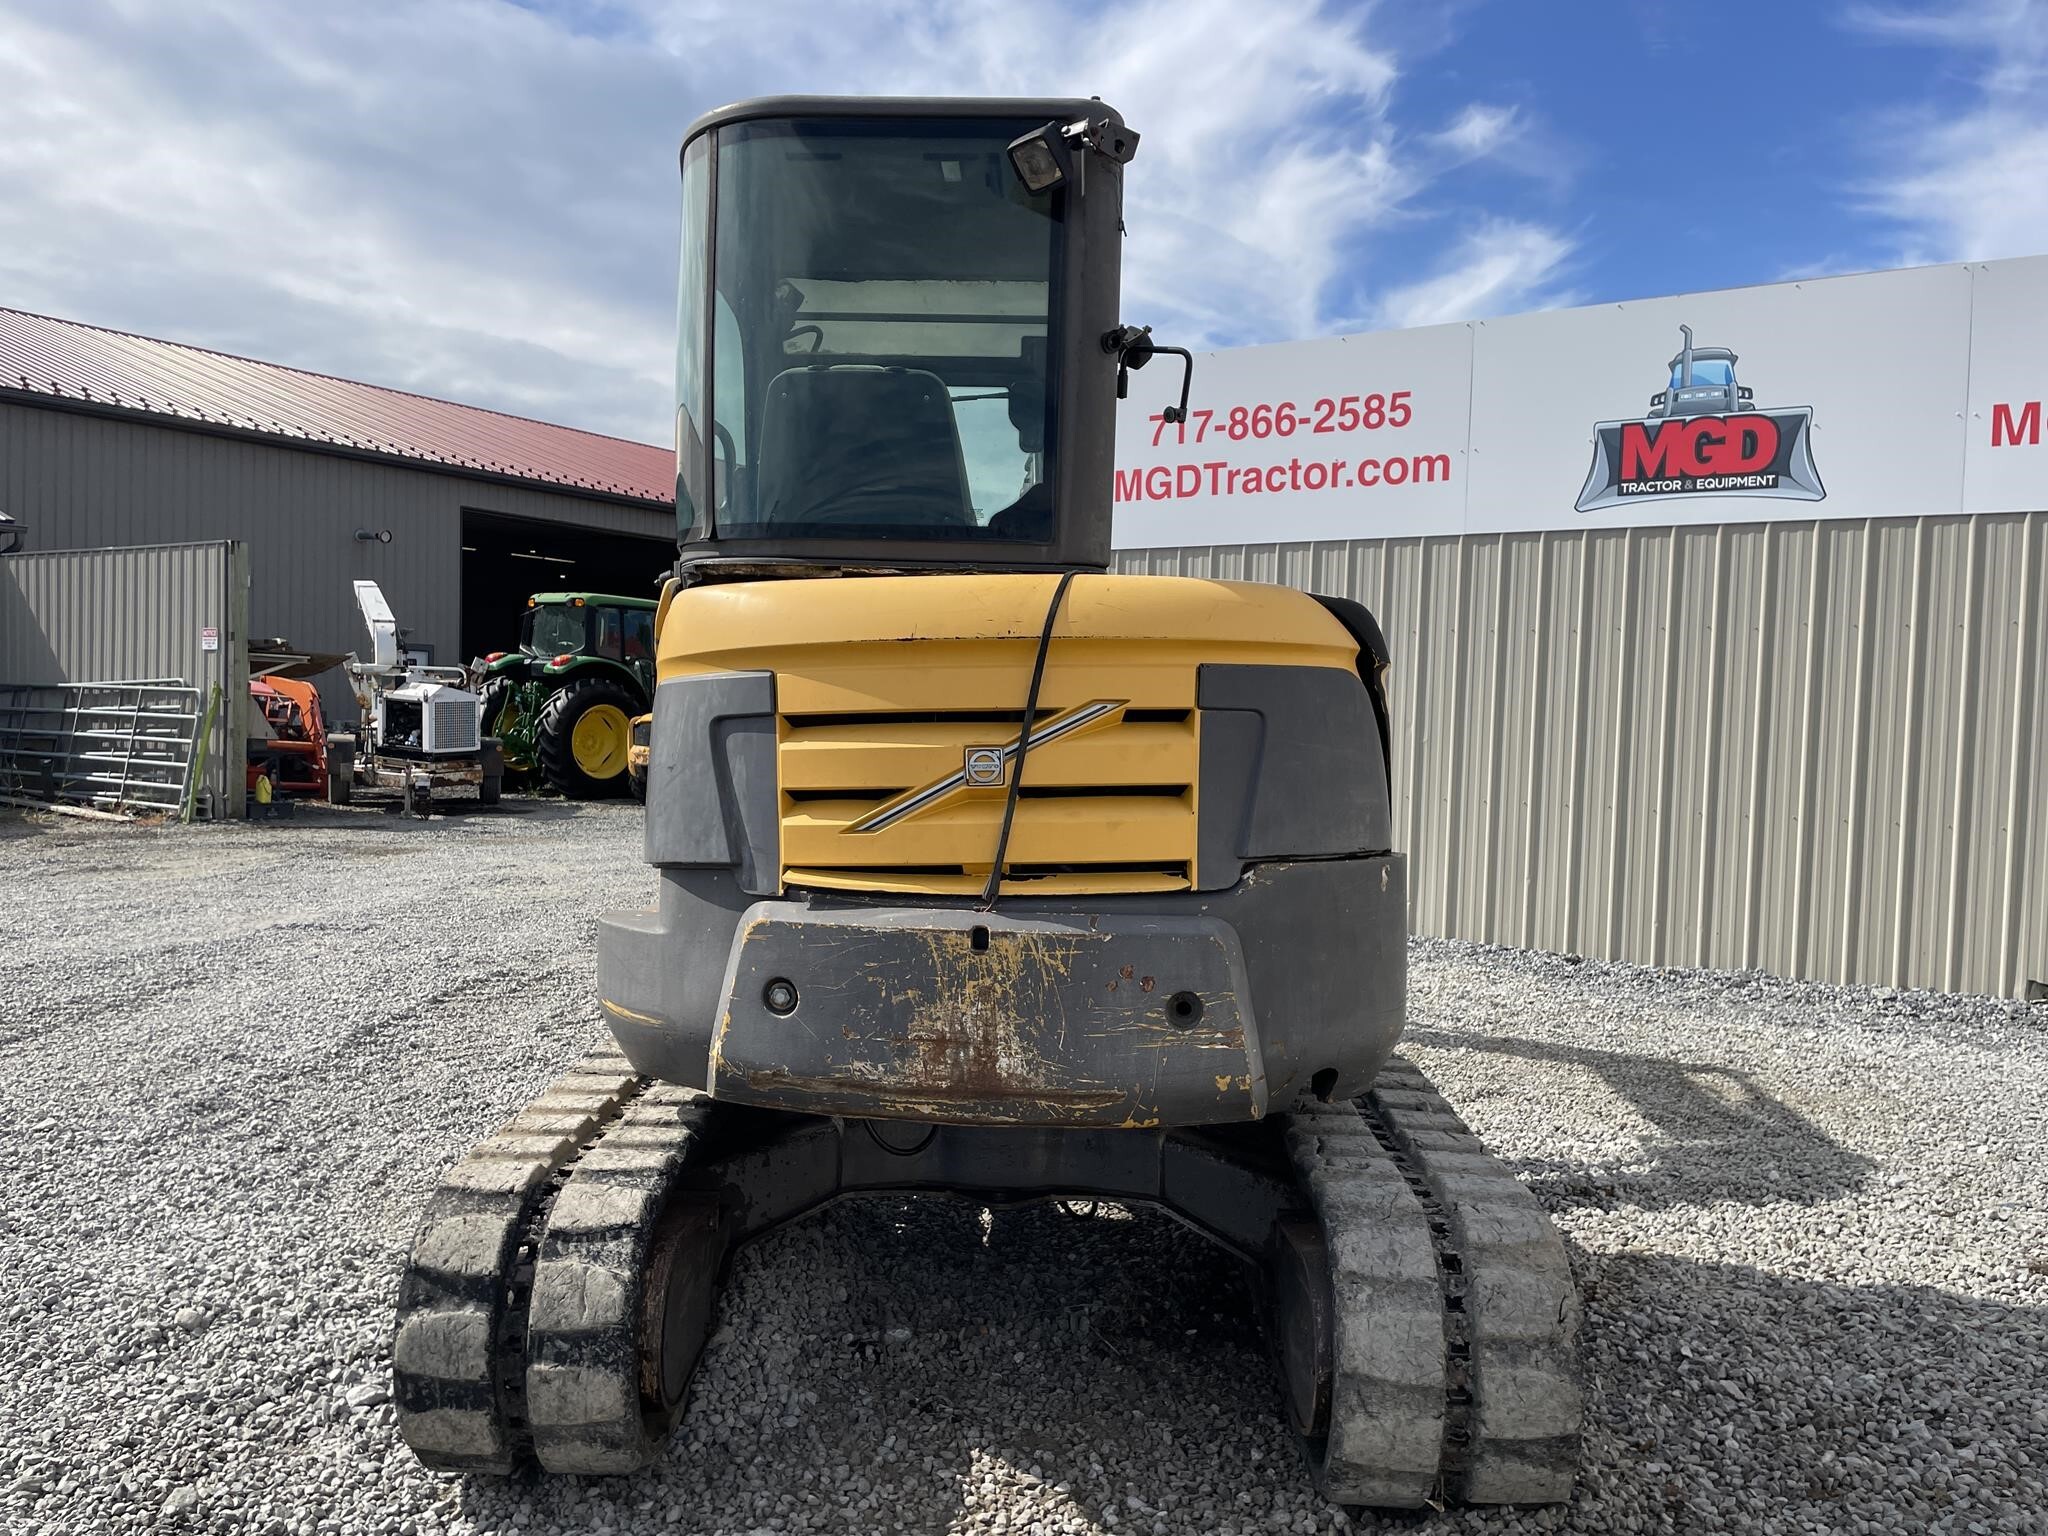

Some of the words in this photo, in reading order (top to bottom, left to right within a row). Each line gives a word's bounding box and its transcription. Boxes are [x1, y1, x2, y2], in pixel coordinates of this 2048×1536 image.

[1149, 391, 1412, 446] 717-866-2585
[1992, 401, 2048, 447] M
[1620, 414, 1778, 480] MGD
[1115, 454, 1450, 502] MGDTractor.com
[1621, 481, 1682, 493] TRACTOR
[1684, 479, 1694, 490] &
[1696, 475, 1776, 490] EQUIPMENT
